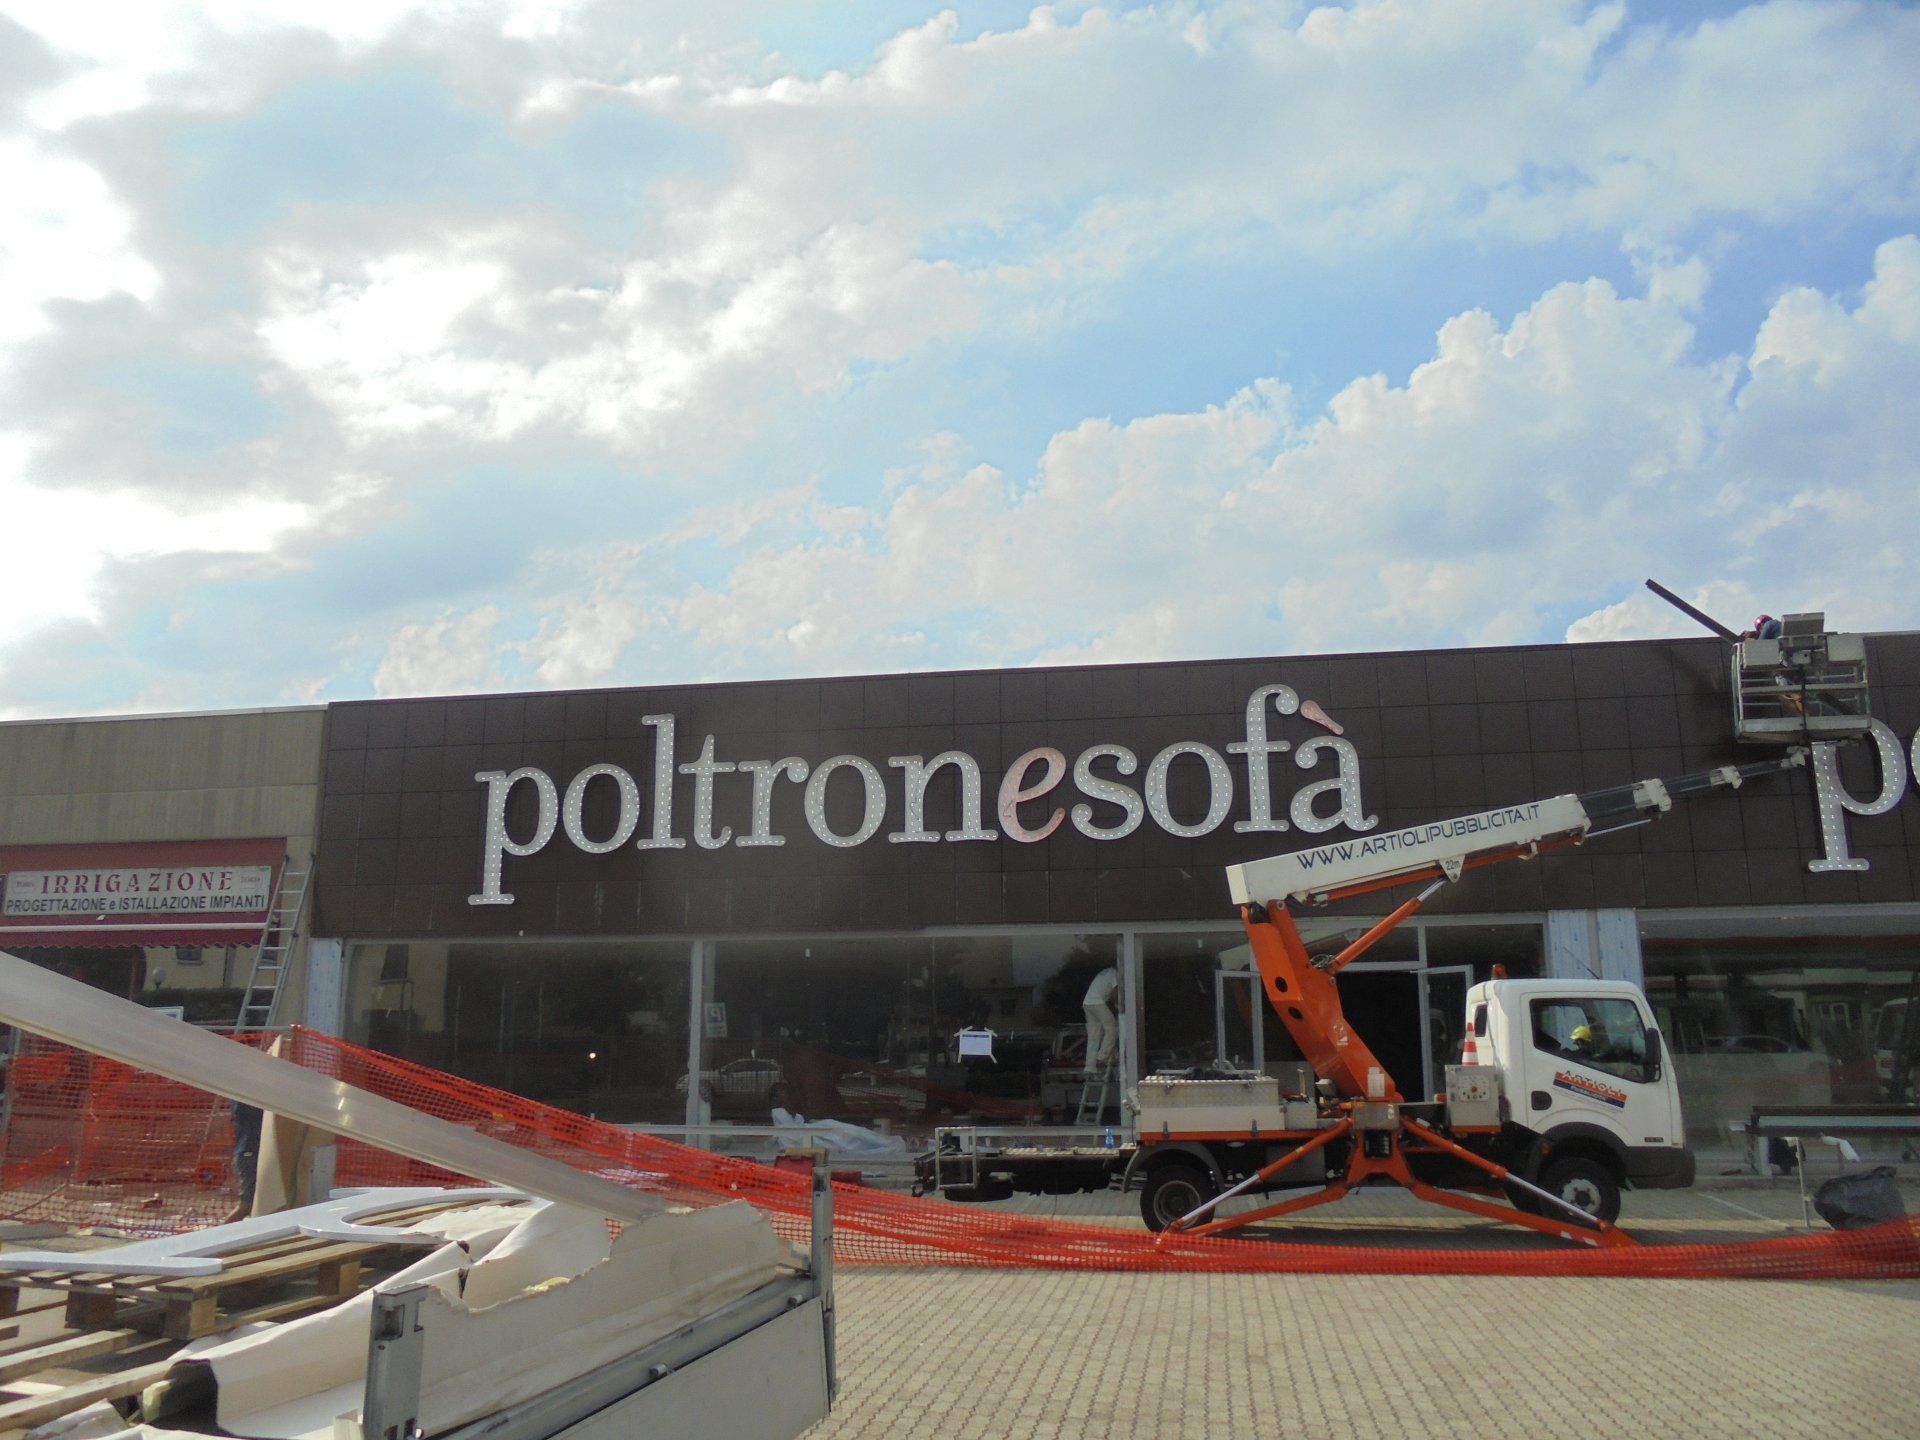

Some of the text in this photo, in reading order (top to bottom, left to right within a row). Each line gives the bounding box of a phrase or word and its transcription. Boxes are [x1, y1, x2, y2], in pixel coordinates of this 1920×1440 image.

[467, 683, 1380, 906] poltronesofà
[1296, 804, 1540, 870] WWW.ARTIOLIPUBBLICITA.IT
[40, 871, 233, 894] IRRIGAZIONE
[6, 894, 265, 912] PROGETTAZIONE e ISTALLAZIONE IMPIANTI
[1562, 1070, 1623, 1097] ARTIOLI
